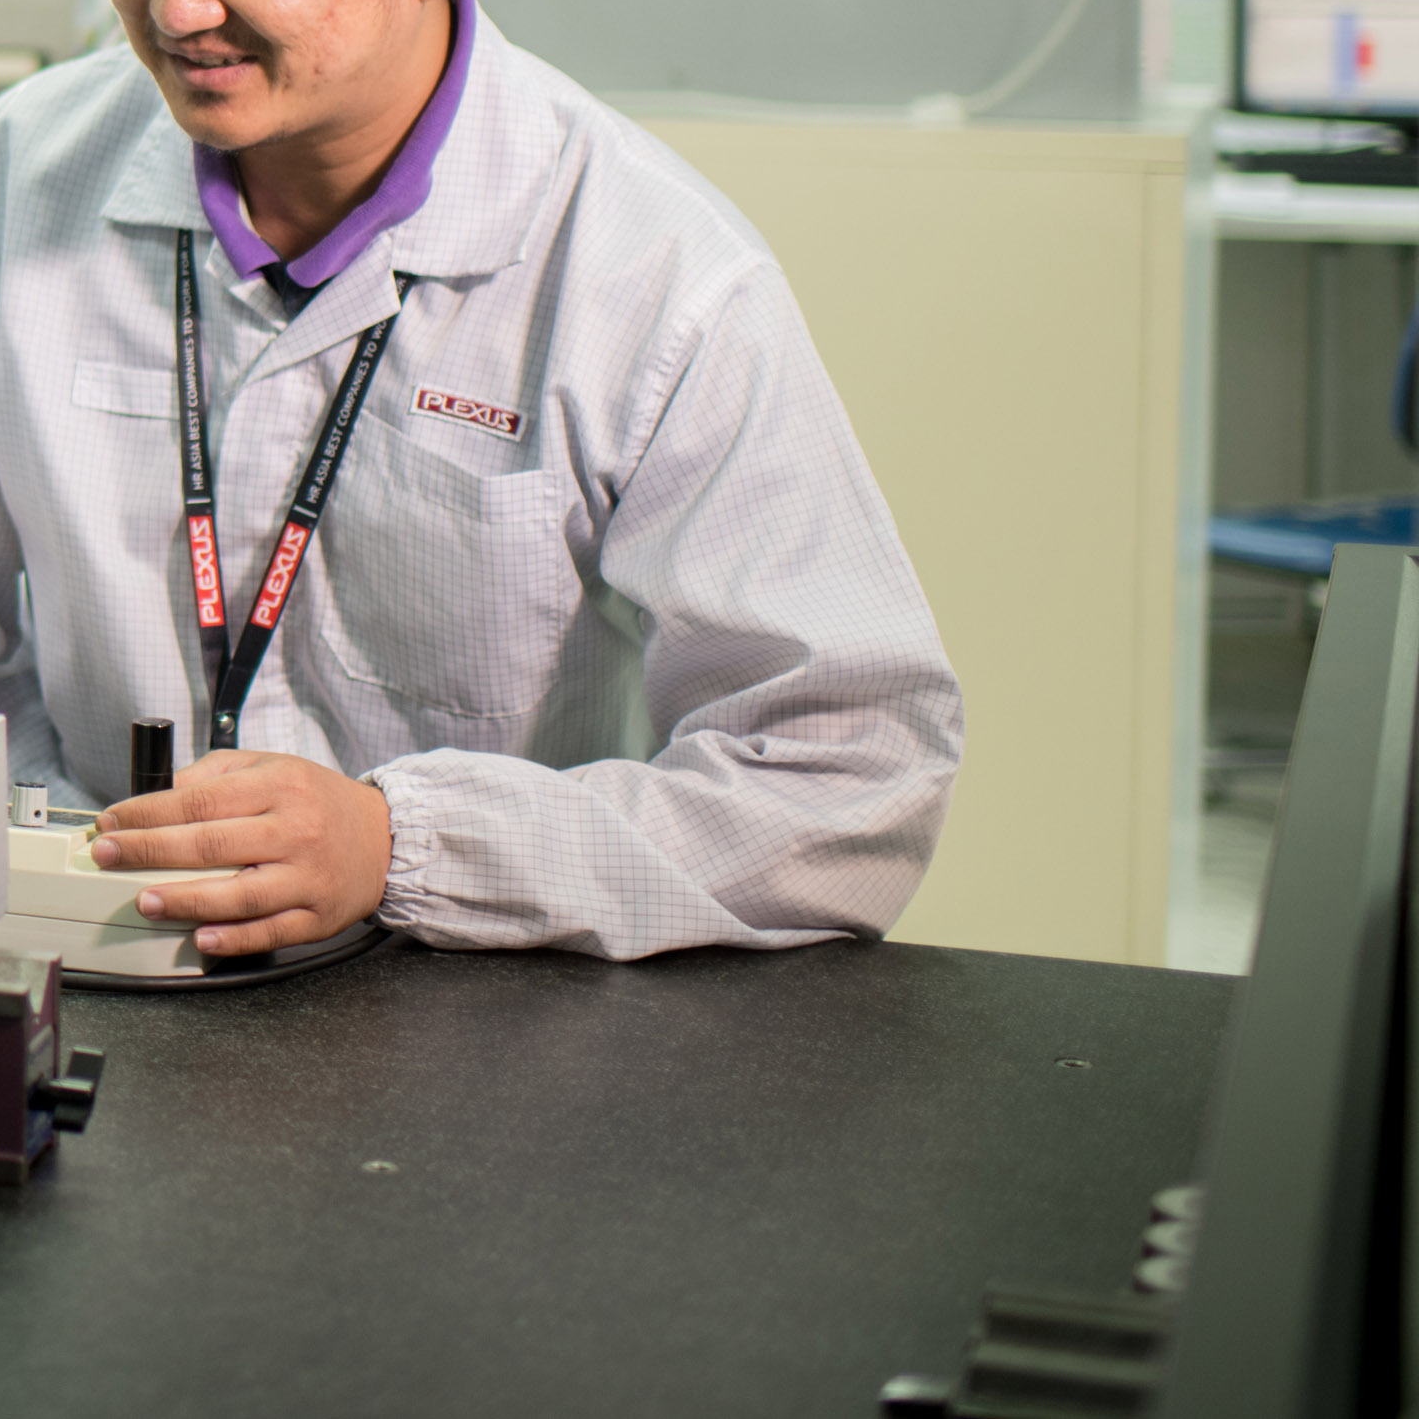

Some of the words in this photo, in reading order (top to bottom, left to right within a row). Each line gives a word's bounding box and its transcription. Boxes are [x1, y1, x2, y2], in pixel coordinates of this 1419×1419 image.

[183, 317, 194, 335] TO
[363, 341, 378, 358] TO
[184, 338, 199, 408] COMPANIES
[337, 361, 370, 428] COMPANIES
[188, 410, 201, 441] BEST
[424, 393, 515, 432] PLEXUS
[189, 442, 203, 471] ASIA
[324, 426, 344, 458] BEST
[192, 471, 204, 491] HR
[317, 458, 334, 490] ASIA
[306, 485, 323, 504] HR
[190, 517, 221, 624] PLEXUS
[254, 525, 307, 627] PLEXUS
